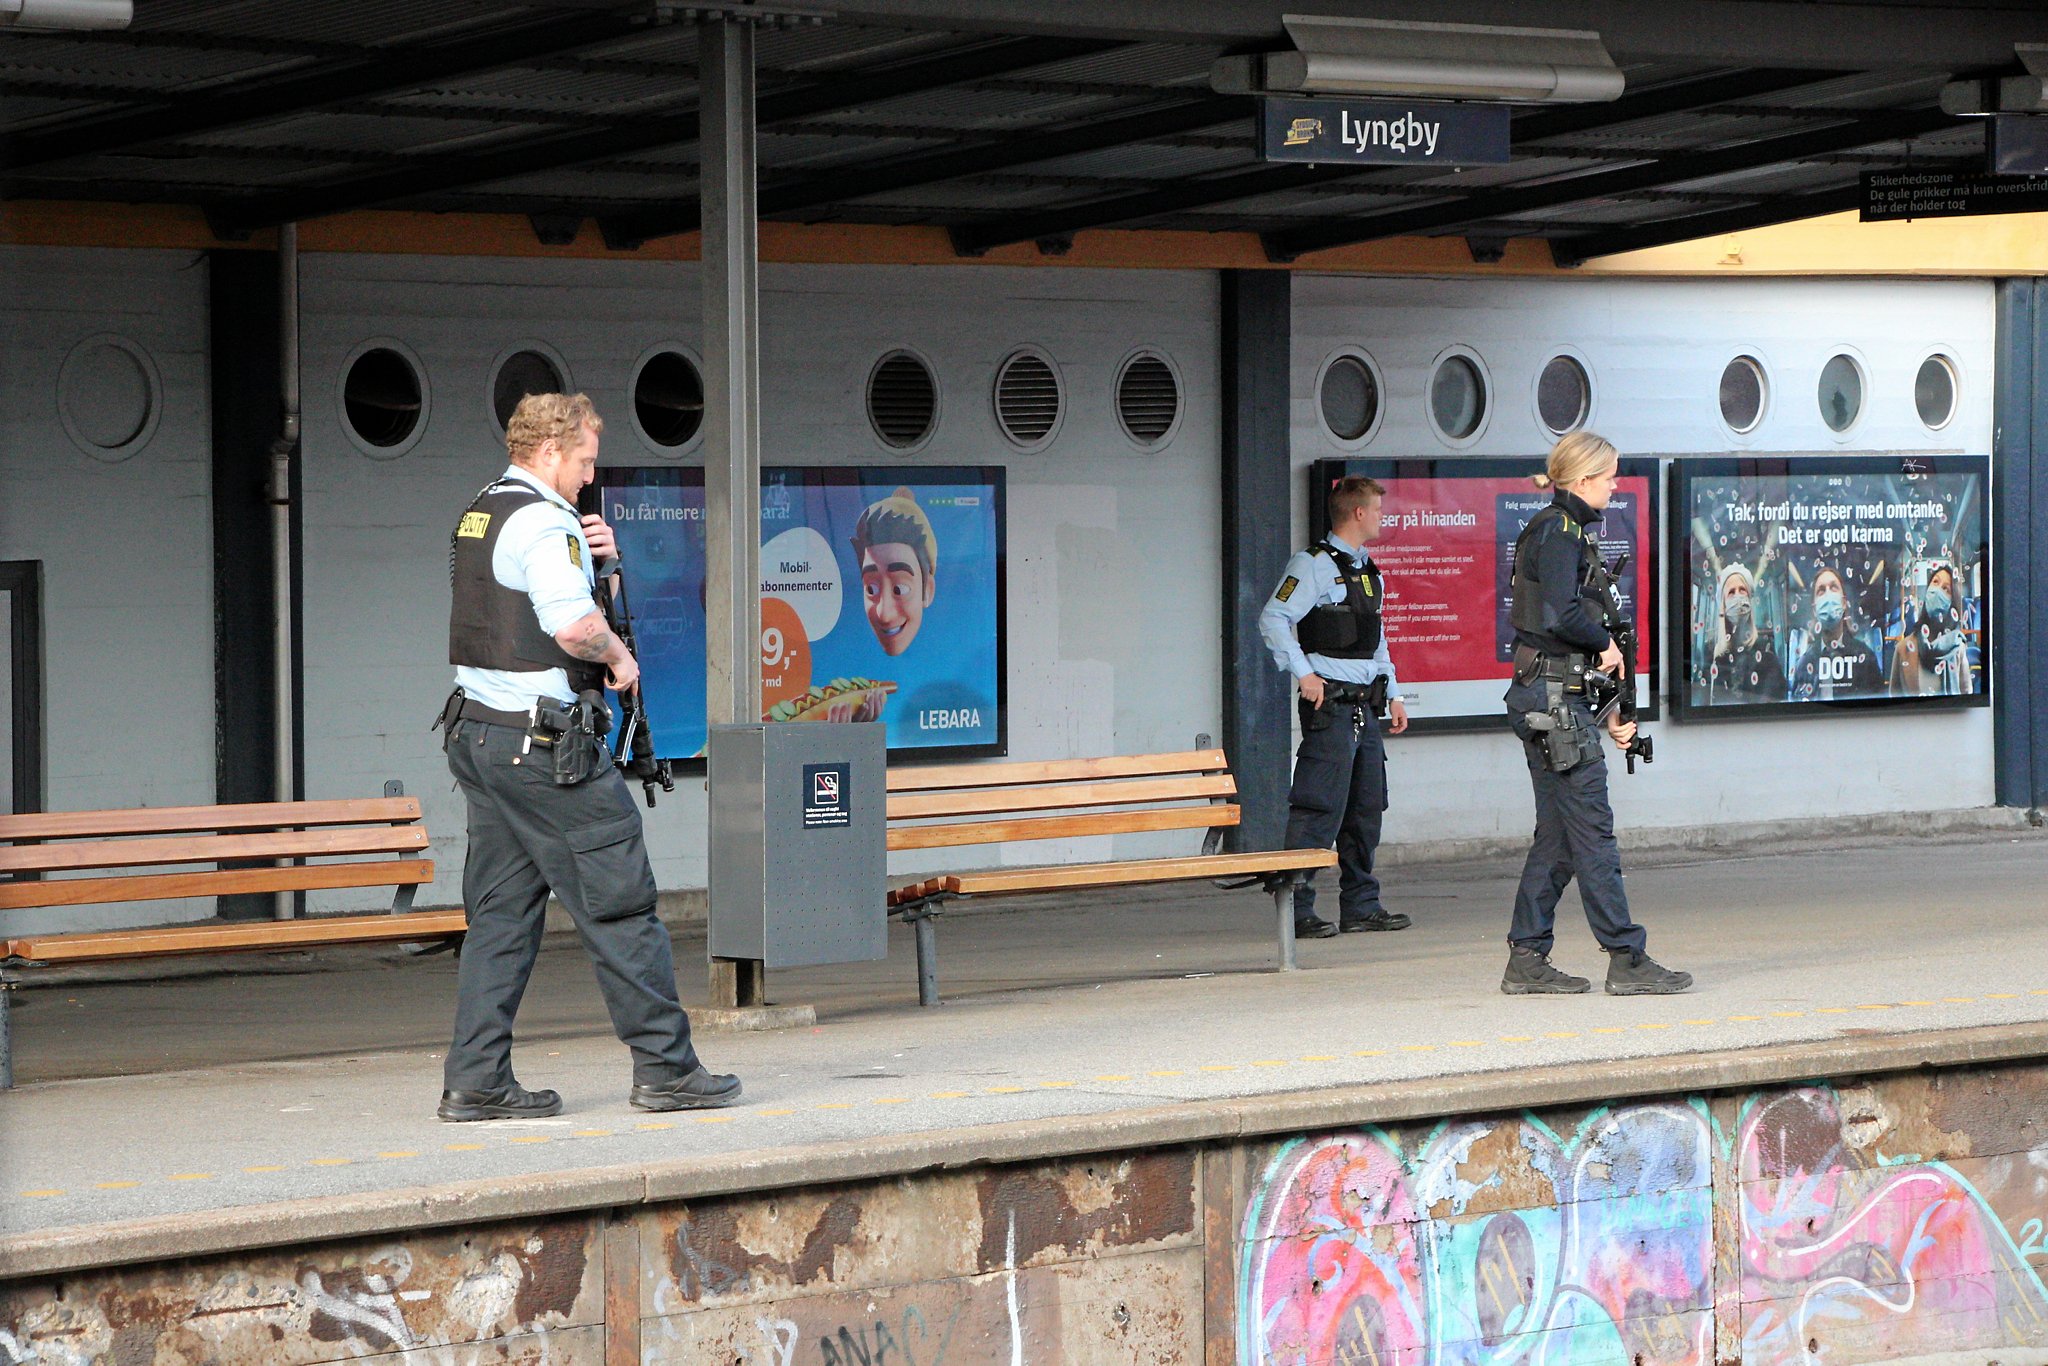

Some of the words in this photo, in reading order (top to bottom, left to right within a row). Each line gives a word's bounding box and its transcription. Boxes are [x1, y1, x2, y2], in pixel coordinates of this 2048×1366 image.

[1341, 110, 1440, 156] Lyngby
[1870, 173, 1954, 187] Sikkerhedszone
[1870, 189, 1884, 201] De
[1887, 188, 1911, 202] gule
[1913, 186, 1951, 202] prikker
[1953, 184, 1970, 196] må
[1973, 184, 1994, 195] kun
[1996, 179, 2048, 194] overskrid
[1870, 201, 1888, 214] når
[1889, 201, 1908, 213] der
[1909, 199, 1946, 212] holder
[1948, 199, 1966, 211] tog
[614, 503, 634, 521] Du
[638, 502, 656, 521] får
[661, 506, 699, 521] mere
[1381, 513, 1401, 527] ser
[1402, 509, 1419, 531] på
[1421, 509, 1476, 526] hinanden
[1726, 503, 1756, 523] Tak,
[1757, 501, 1790, 521] fordi
[1793, 502, 1809, 521] du
[1812, 500, 1852, 524] rejser
[1855, 501, 1883, 520] med
[1886, 500, 1944, 519] omtanke
[1778, 526, 1803, 545] Det
[1806, 529, 1821, 544] er
[1823, 525, 1849, 547] god
[1851, 524, 1893, 543] karma
[780, 561, 812, 573] Mobil-
[760, 580, 833, 592] abonnementer
[761, 627, 797, 670] 9,-
[1818, 656, 1853, 680] DOT
[765, 675, 782, 687] md
[919, 707, 981, 730] LEBARA
